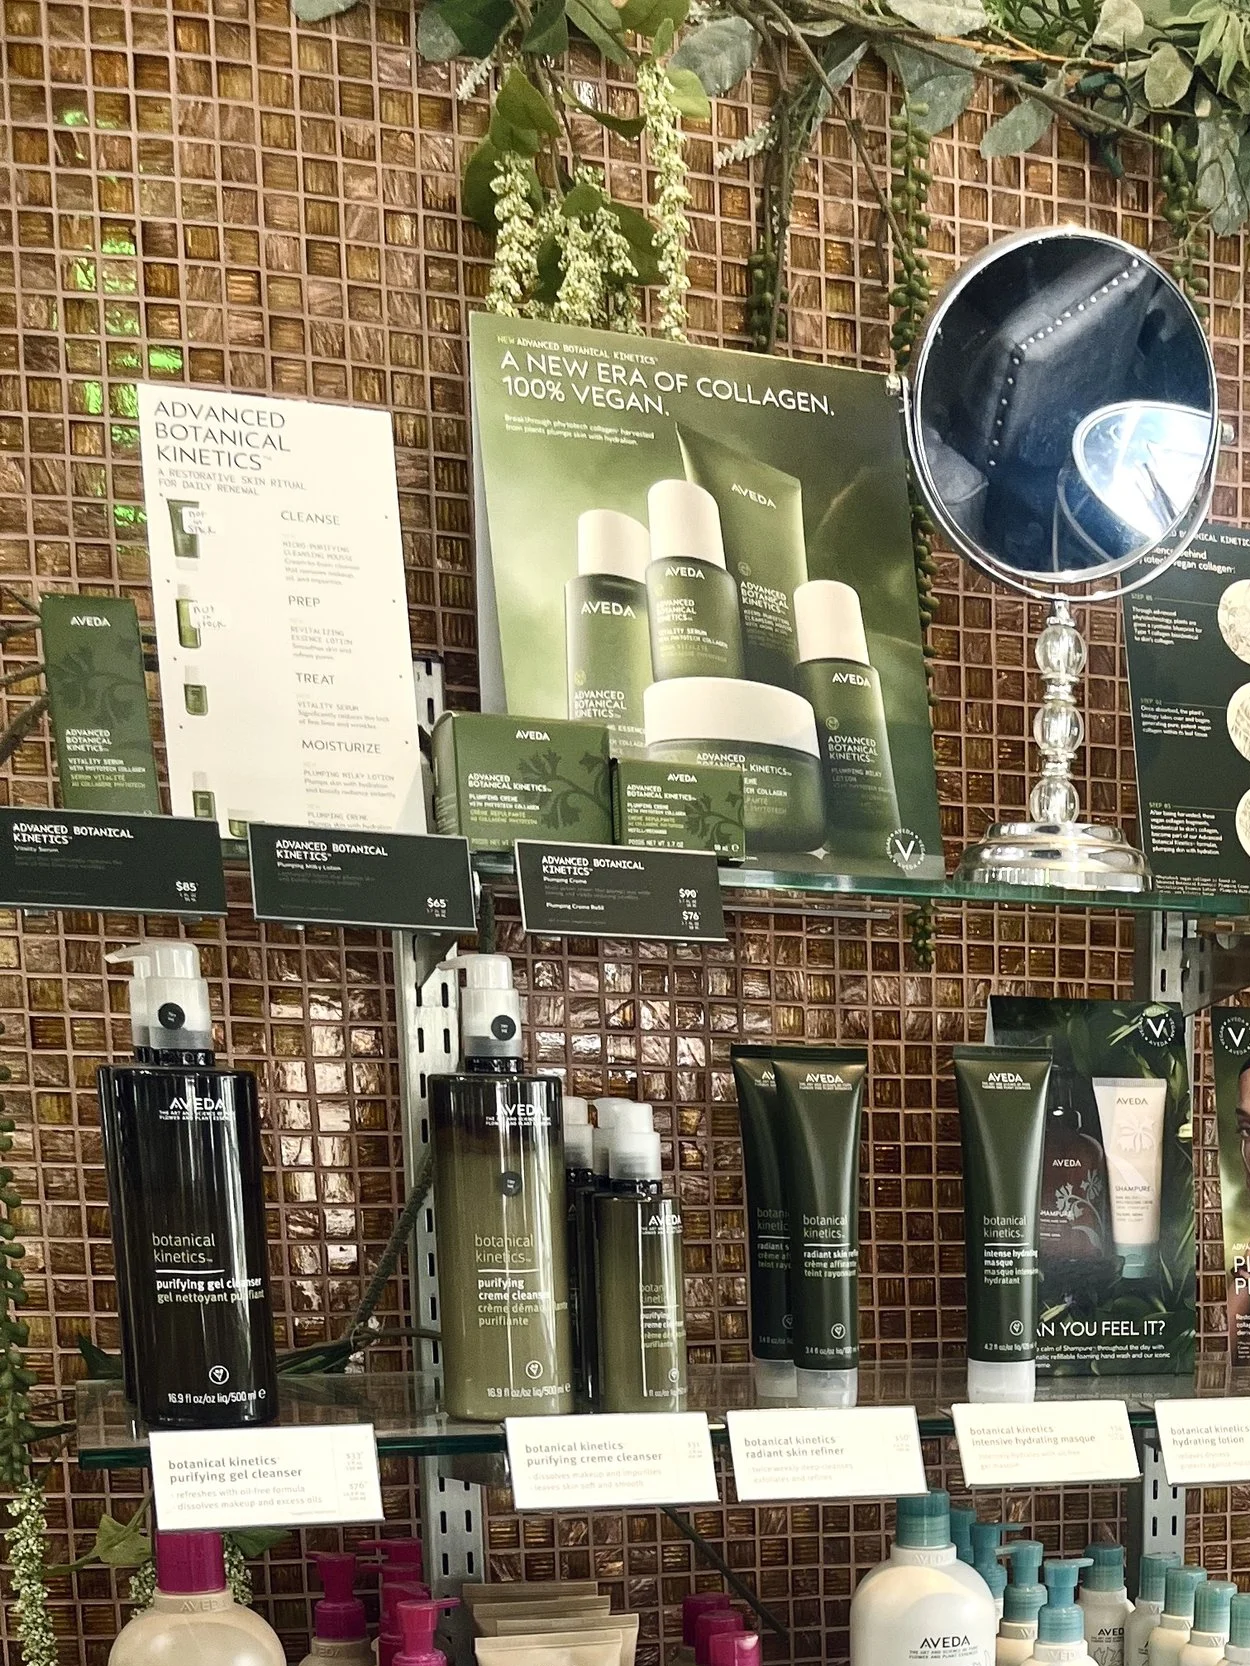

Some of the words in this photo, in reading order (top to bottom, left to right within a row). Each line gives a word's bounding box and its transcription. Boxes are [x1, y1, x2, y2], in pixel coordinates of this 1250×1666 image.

[501, 351, 519, 370] A
[528, 353, 588, 379] NEW
[597, 362, 647, 388] ERA
[654, 370, 688, 394] OF
[696, 377, 835, 416] COLLAGEN.
[502, 376, 566, 402] 100%
[571, 383, 670, 416] VEGAN.
[154, 401, 286, 429] ADVANCED
[155, 422, 291, 452] BOTANICAL
[158, 468, 164, 477] A
[169, 469, 236, 484] RESTORATIVE
[241, 476, 266, 485] SKIN
[270, 478, 307, 491] RITUAL
[158, 478, 178, 488] FOR
[182, 480, 212, 491] DAILY
[217, 483, 260, 496] RENEWAL
[280, 510, 340, 526] CLEANSE
[288, 595, 321, 608] PREP
[580, 601, 636, 619] AVEDA
[296, 672, 335, 685] TREAT
[832, 672, 872, 689] AVEDA
[302, 739, 381, 755] MOISTURIZE
[12, 822, 68, 835] ADVANCED
[73, 825, 134, 839] BOTANICAL
[276, 839, 327, 852] ADVANCED
[332, 842, 388, 857] BOTANICAL
[542, 856, 589, 868] ADVANCED
[593, 859, 644, 870] BOTANICAL
[987, 1072, 1024, 1084] AVEDA
[803, 1214, 848, 1227] botanical
[151, 1233, 215, 1248] botanical
[474, 1233, 534, 1248] botanical
[478, 1277, 525, 1292] purifying
[1060, 1321, 1097, 1337] YOU
[1102, 1321, 1139, 1336] FEEL
[1144, 1320, 1165, 1336] IT?
[1172, 1436, 1216, 1448] hydrating
[1218, 1435, 1244, 1444] lotion
[526, 1453, 578, 1468] purifying
[580, 1453, 614, 1464] creme
[616, 1451, 663, 1462] cleanser
[176, 1488, 218, 1501] refreshes
[220, 1487, 238, 1497] with
[919, 1635, 971, 1650] AVEDA
